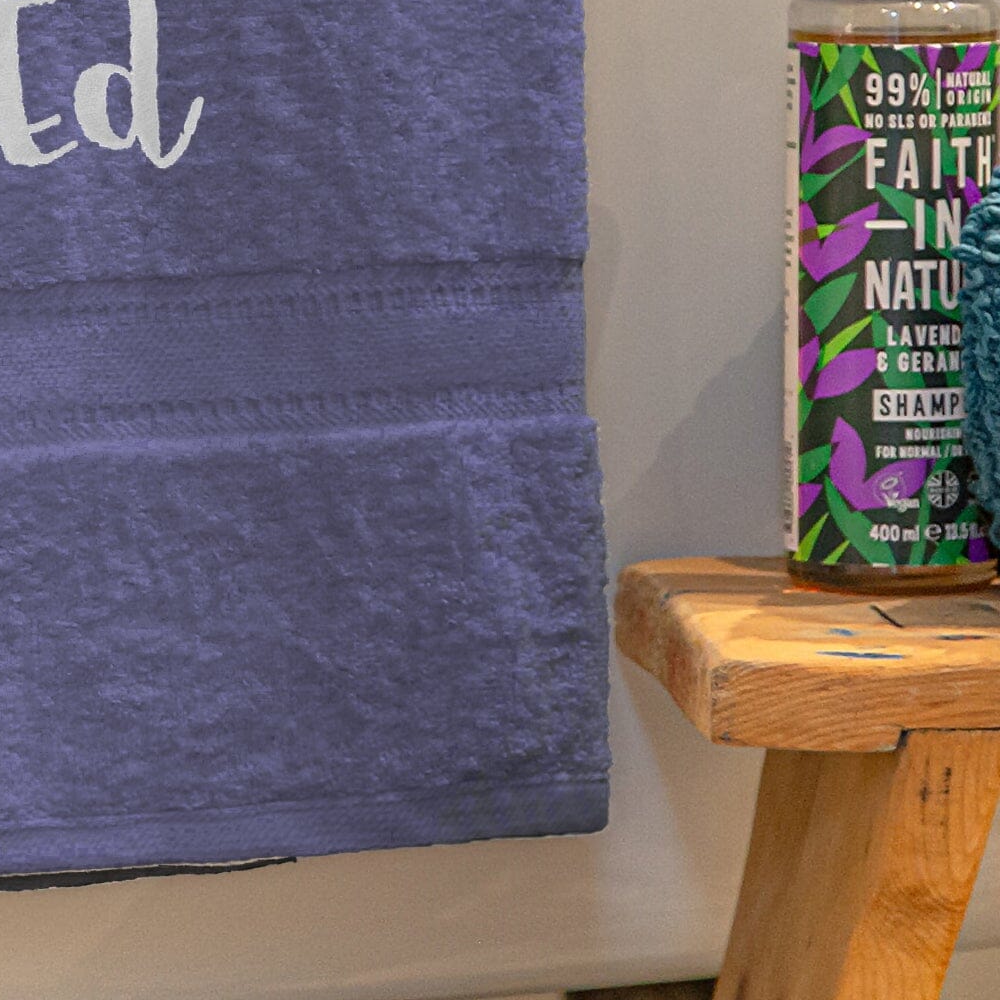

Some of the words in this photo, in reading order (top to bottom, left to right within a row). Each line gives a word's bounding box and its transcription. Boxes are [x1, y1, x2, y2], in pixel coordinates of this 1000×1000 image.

[865, 72, 931, 107] 99%
[945, 71, 992, 89] NATURAL
[946, 88, 992, 106] ORIGIN
[864, 113, 884, 129] NO
[888, 113, 915, 129] SLS
[919, 113, 937, 128] OR
[865, 135, 992, 189] FAITH
[864, 259, 965, 311] NATU
[897, 350, 965, 373] GERAN
[869, 523, 900, 542] 400
